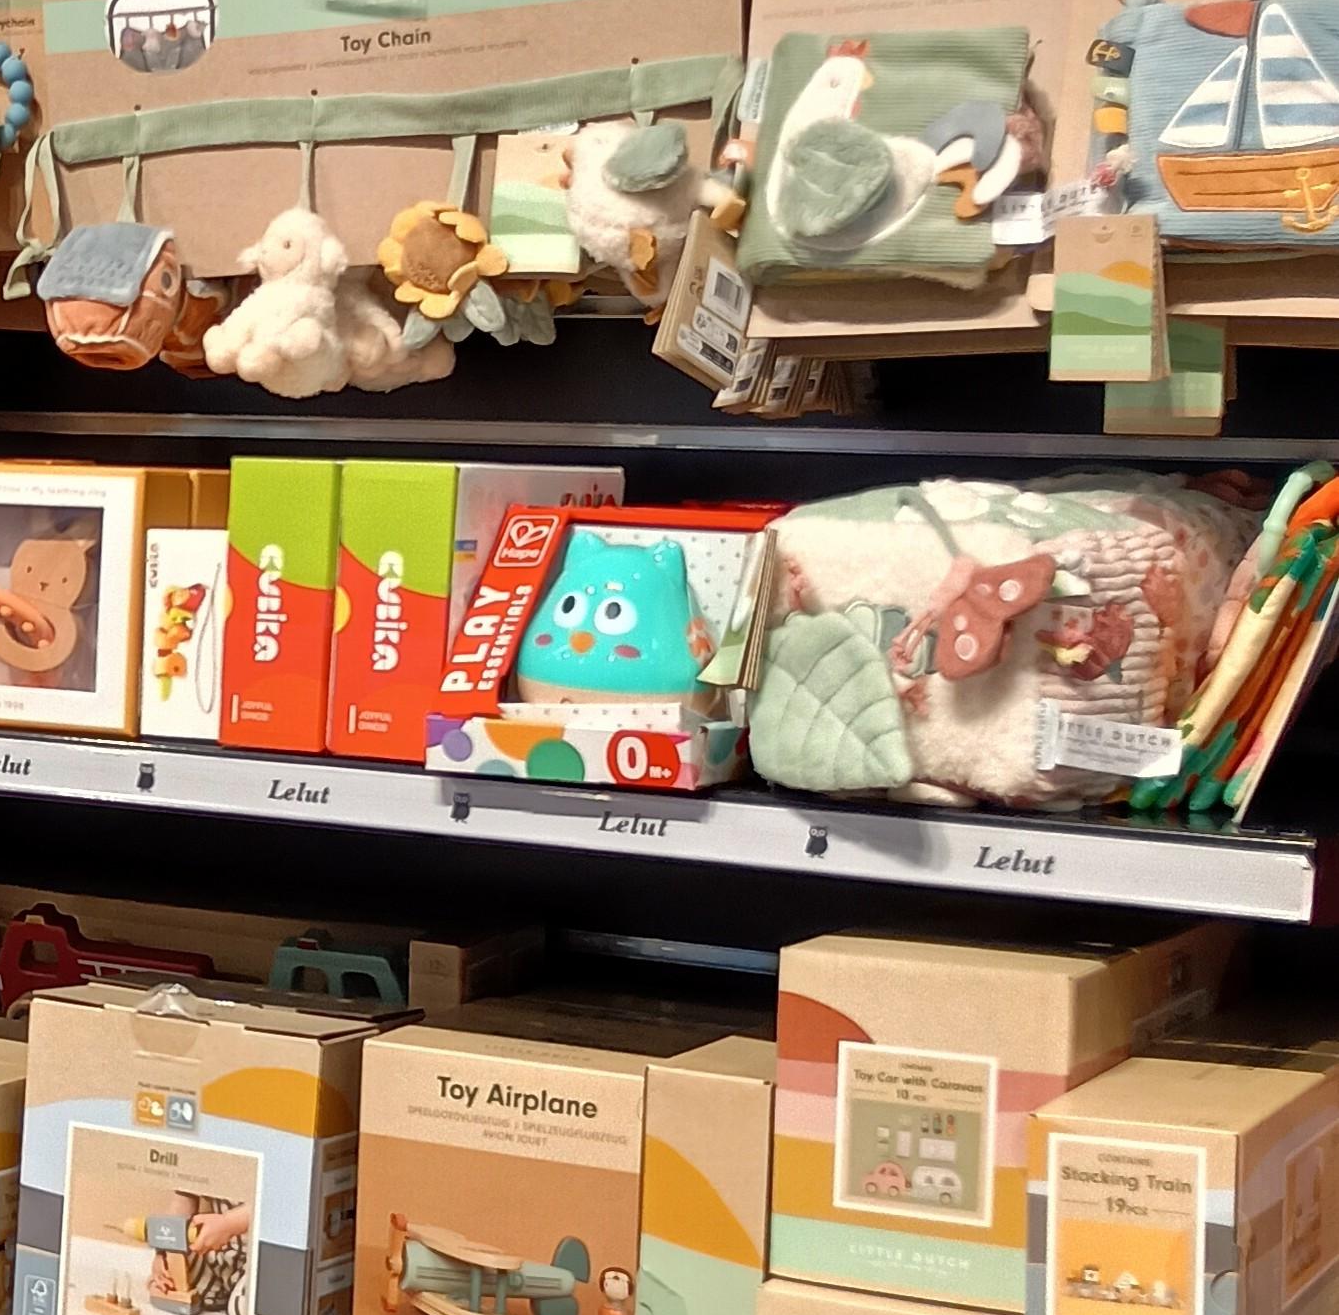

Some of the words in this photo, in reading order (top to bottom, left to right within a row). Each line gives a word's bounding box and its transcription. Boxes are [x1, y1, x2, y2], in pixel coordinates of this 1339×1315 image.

[340, 32, 372, 56] Toy
[377, 26, 432, 50] Chain
[500, 543, 541, 562] Hape
[441, 580, 512, 695] PLAY
[476, 583, 534, 692] ESSENTIALS
[1112, 728, 1174, 748] DUTCH
[268, 779, 330, 806] Lelut
[598, 809, 669, 839] Lelut
[974, 845, 1058, 877] Lelut
[853, 1068, 874, 1084] Toy
[877, 1070, 900, 1086] Car
[902, 1073, 928, 1088] with
[931, 1078, 984, 1095] Caravan
[436, 1074, 482, 1106] Toy
[487, 1081, 599, 1121] Airplane
[149, 1147, 178, 1168] Drill
[1061, 1165, 1140, 1192] Stacking
[1147, 1173, 1192, 1196] Train
